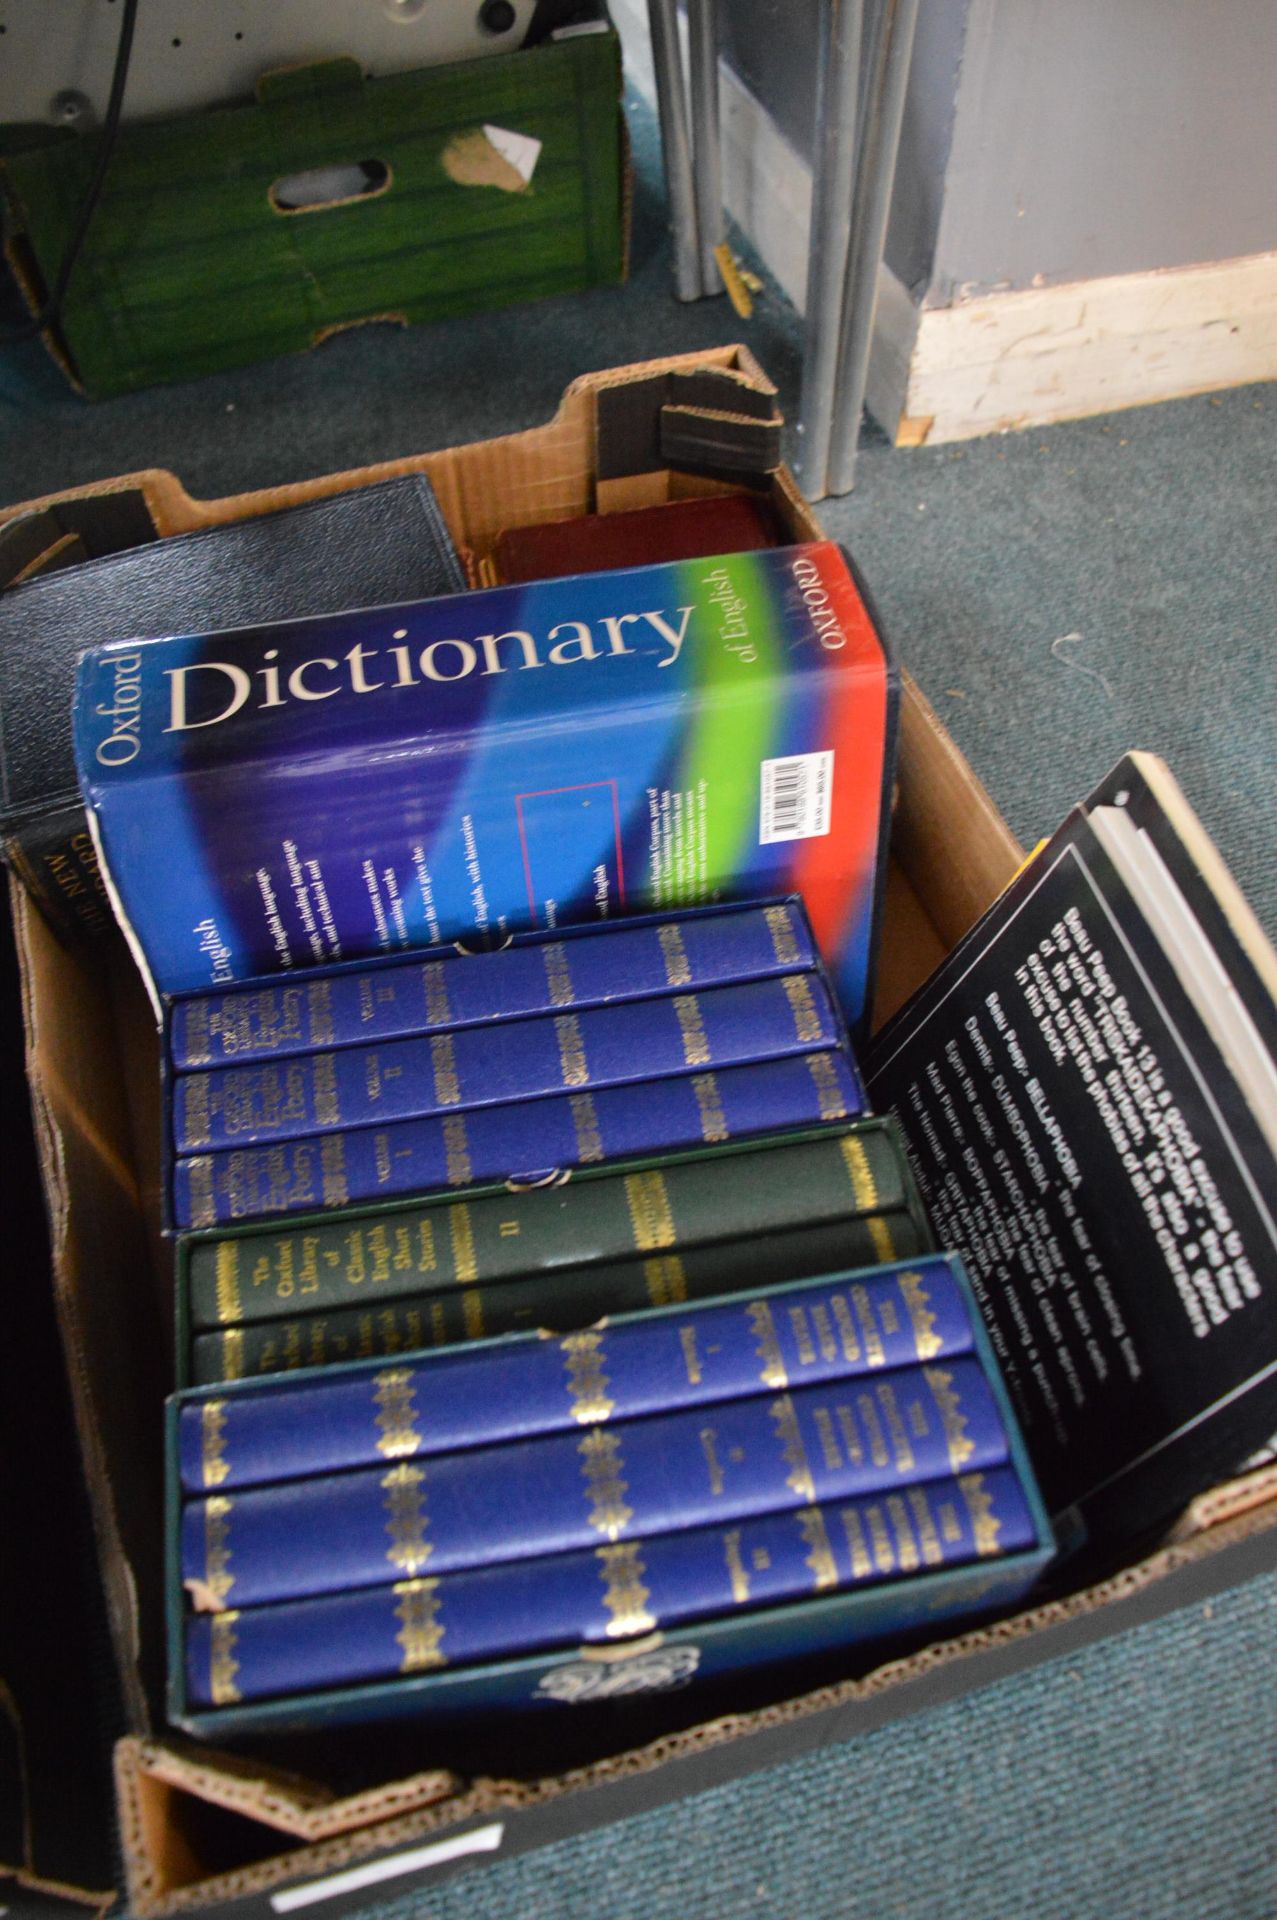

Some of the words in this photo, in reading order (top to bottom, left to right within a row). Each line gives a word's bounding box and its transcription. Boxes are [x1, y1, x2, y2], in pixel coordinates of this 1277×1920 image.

[702, 568, 748, 640] English
[792, 559, 847, 650] OXFORD
[162, 604, 698, 733] Dictionary
[723, 643, 758, 663] of
[96, 652, 142, 767] Oxford
[409, 845, 425, 863] the
[457, 814, 478, 860] histories
[281, 839, 305, 886] language
[304, 859, 322, 880] and
[359, 859, 379, 893] makes
[380, 867, 399, 898] works
[413, 863, 432, 884] give
[465, 860, 481, 884] with
[590, 864, 608, 900] English
[292, 885, 316, 931] including
[309, 880, 334, 924] technical
[419, 884, 434, 904] text
[422, 905, 437, 921] the
[265, 914, 289, 950] English
[320, 924, 337, 943] and
[387, 897, 408, 939] meaning
[1062, 904, 1094, 956] Beau
[193, 918, 232, 984] English
[1037, 933, 1057, 960] of
[1014, 963, 1031, 987] in
[1025, 948, 1063, 1015] excuse
[1050, 959, 1073, 995] the
[1084, 948, 1118, 1002] Peep
[1022, 982, 1046, 1020] this
[1053, 1006, 1072, 1032] to
[1109, 992, 1144, 1049] Book
[1037, 1013, 1070, 1069] book.
[1061, 1022, 1085, 1058] list
[1068, 993, 1109, 1067] number
[925, 1059, 946, 1096] Mad
[942, 1037, 968, 1080] Egon
[960, 1074, 979, 1104] the
[1074, 1049, 1097, 1086] the
[1133, 1041, 1158, 1074] 13
[984, 989, 1010, 1033] Beau
[1024, 1074, 1084, 1192] BELLAPHOBIA
[1146, 1067, 1167, 1093] is
[1157, 1087, 1173, 1107] a
[990, 1072, 1051, 1196] DUMBOPHOBIA
[1050, 919, 1073, 955] the
[1065, 947, 1096, 999] word
[1197, 1226, 1228, 1270] the
[1213, 1263, 1248, 1313] fear
[1085, 1076, 1133, 1158] phobias
[1161, 1101, 1201, 1163] good
[1120, 1147, 1143, 1177] of
[936, 1187, 953, 1215] the
[1057, 1187, 1079, 1220] the
[1129, 1166, 1154, 1200] all
[1187, 1155, 1234, 1236] excuse
[499, 1221, 520, 1238] II
[972, 1203, 990, 1232] the
[1140, 1191, 1168, 1232] the
[1159, 1187, 1191, 1238] also
[367, 1224, 391, 1282] English
[393, 1227, 413, 1271] Short
[418, 1219, 438, 1272] Stories
[983, 1230, 1003, 1264] fear
[1032, 1206, 1053, 1238] the
[1044, 1235, 1067, 1271] fear
[1058, 1268, 1075, 1292] of
[1069, 1215, 1093, 1252] fear
[1181, 1239, 1201, 1263] a
[1221, 1228, 1246, 1259] to
[253, 1256, 271, 1287] The
[274, 1238, 295, 1298] Oxford
[299, 1236, 320, 1294] Library
[323, 1250, 341, 1267] of
[344, 1230, 366, 1284] Classic
[994, 1262, 1010, 1284] of
[1004, 1213, 1024, 1245] the
[1016, 1242, 1037, 1277] fear
[1029, 1274, 1045, 1297] of
[1083, 1249, 1102, 1274] of
[1150, 1224, 1216, 1340] characters
[1189, 1264, 1230, 1328] good
[1230, 1254, 1263, 1302] use
[999, 1282, 1035, 1349] missing
[1089, 1271, 1128, 1339] closing
